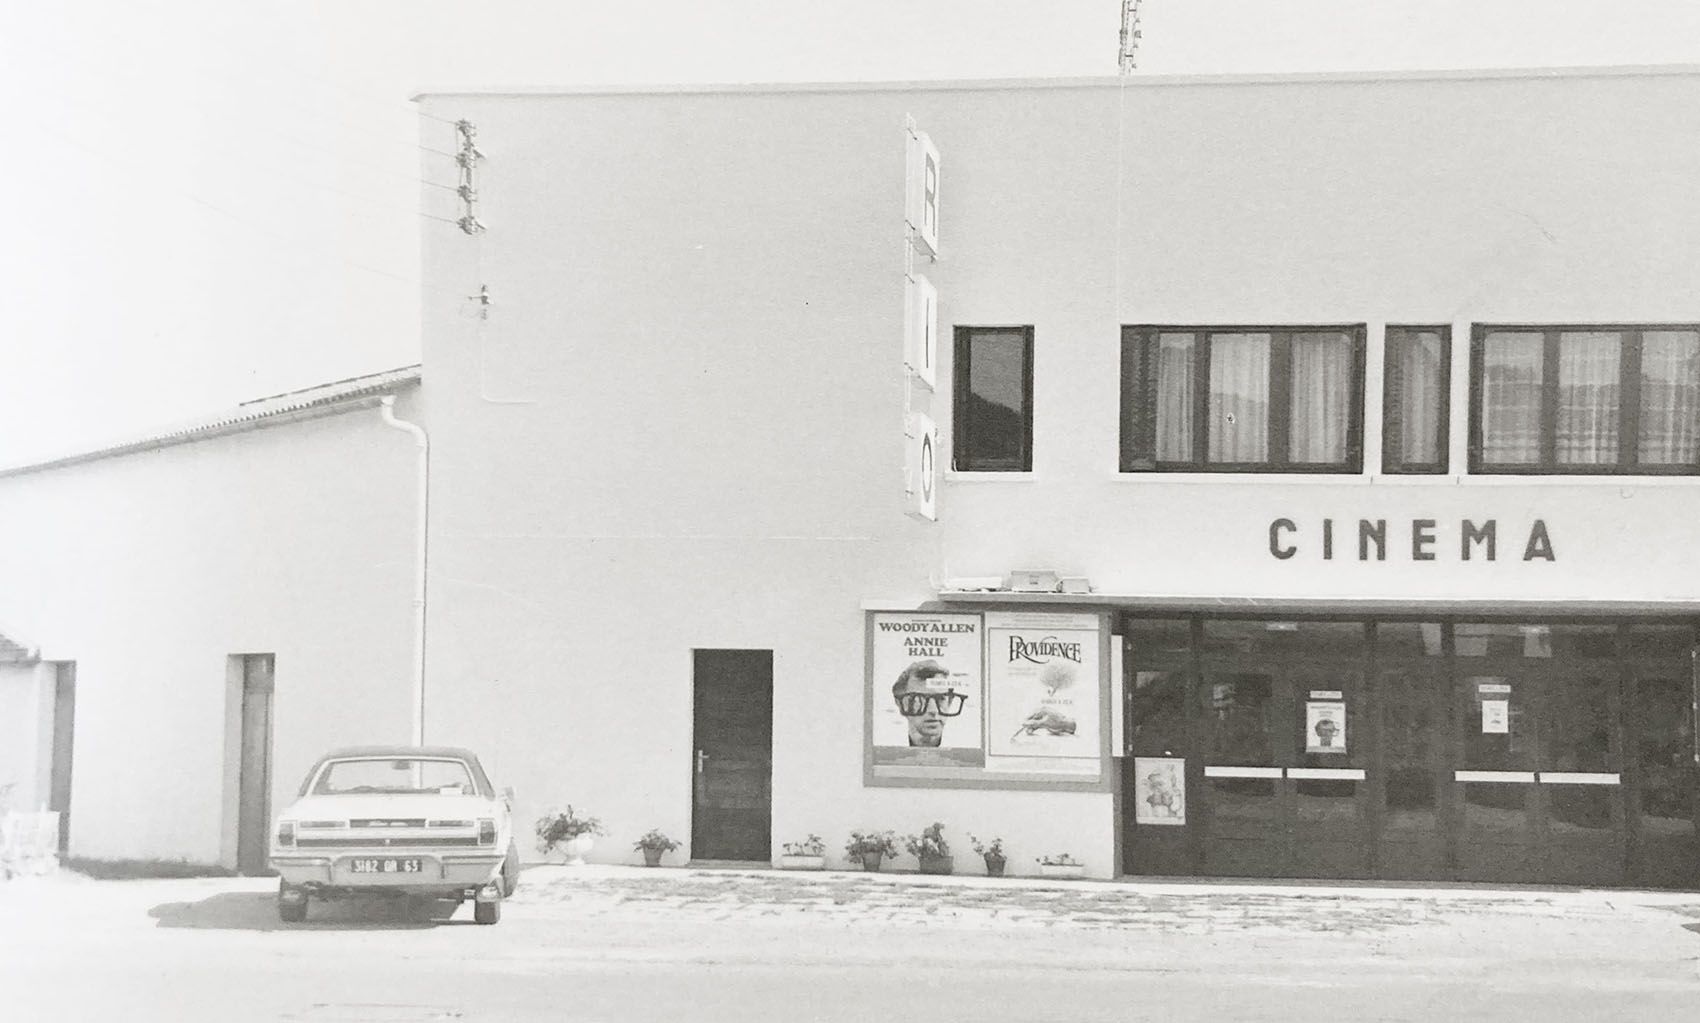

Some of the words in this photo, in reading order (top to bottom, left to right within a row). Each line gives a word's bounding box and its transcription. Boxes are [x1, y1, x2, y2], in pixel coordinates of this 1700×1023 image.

[922, 152, 937, 503] RIO
[1269, 518, 1556, 561] CINEMA
[879, 622, 929, 633] WOODY
[930, 623, 975, 633] ALLEN
[904, 637, 948, 647] ANNIE
[908, 647, 944, 656] HALL
[1008, 635, 1082, 664] PROVIDENCE
